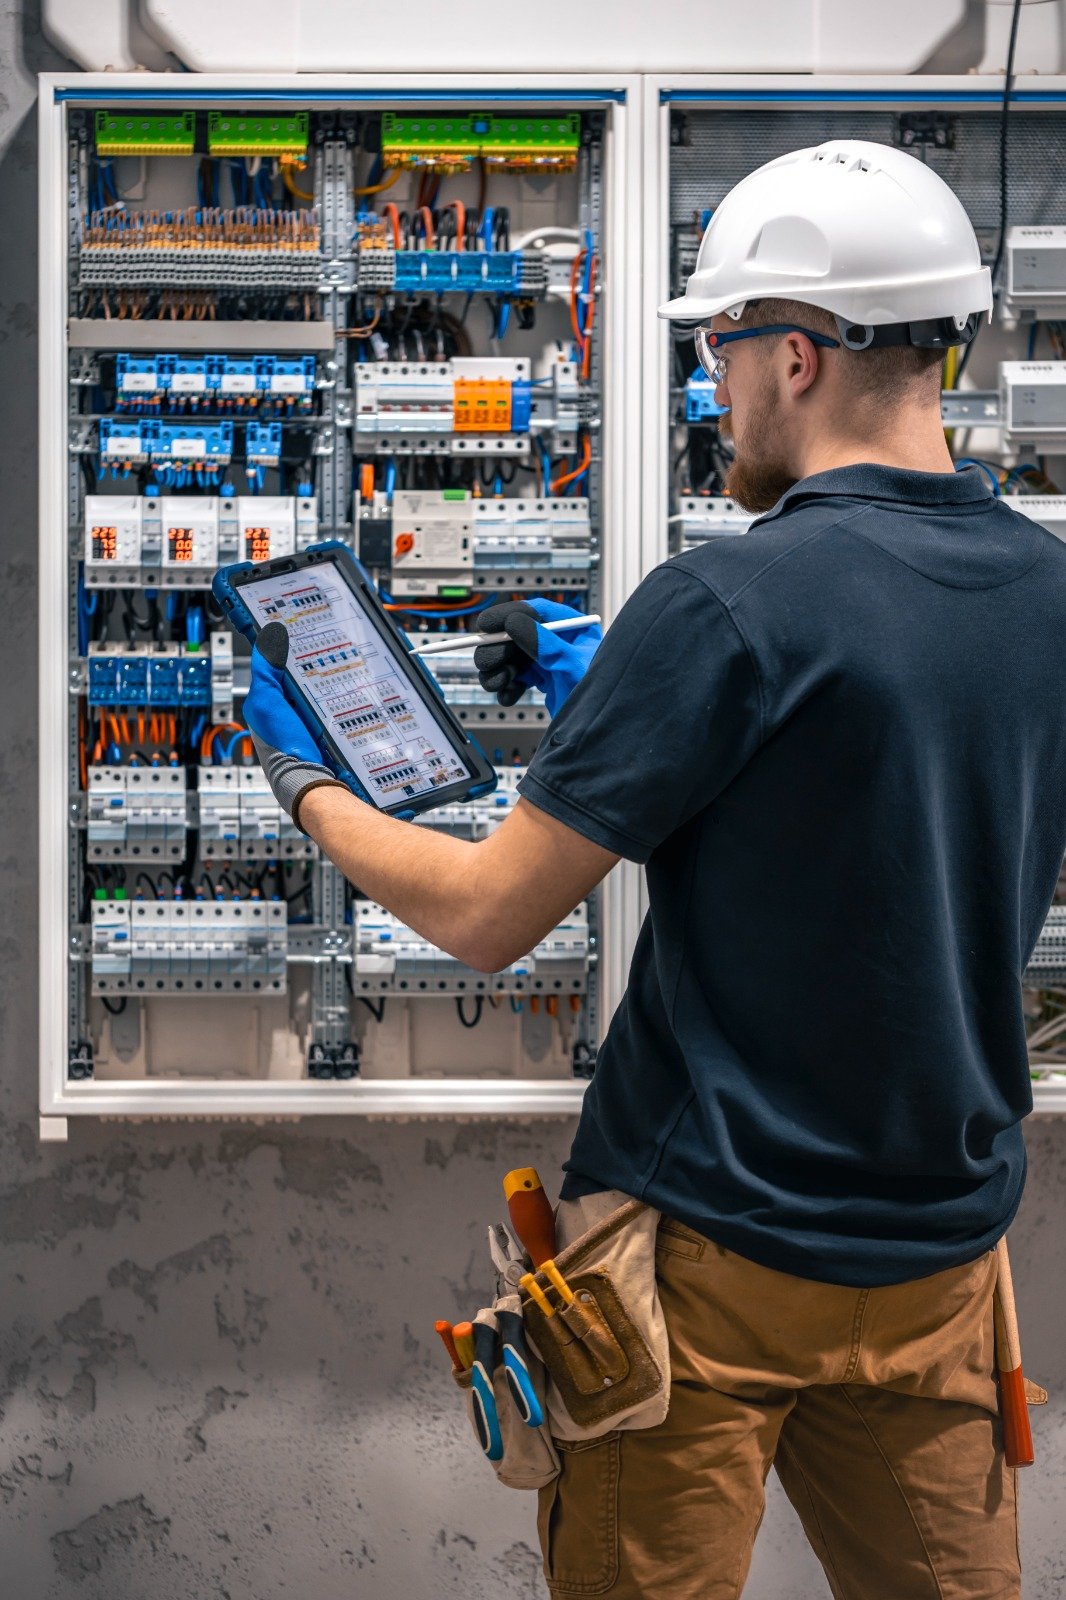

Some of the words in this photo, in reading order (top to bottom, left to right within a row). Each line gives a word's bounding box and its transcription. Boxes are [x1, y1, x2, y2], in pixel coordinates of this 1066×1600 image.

[92, 527, 116, 538] 229
[168, 528, 193, 539] 231
[245, 528, 271, 539] 227
